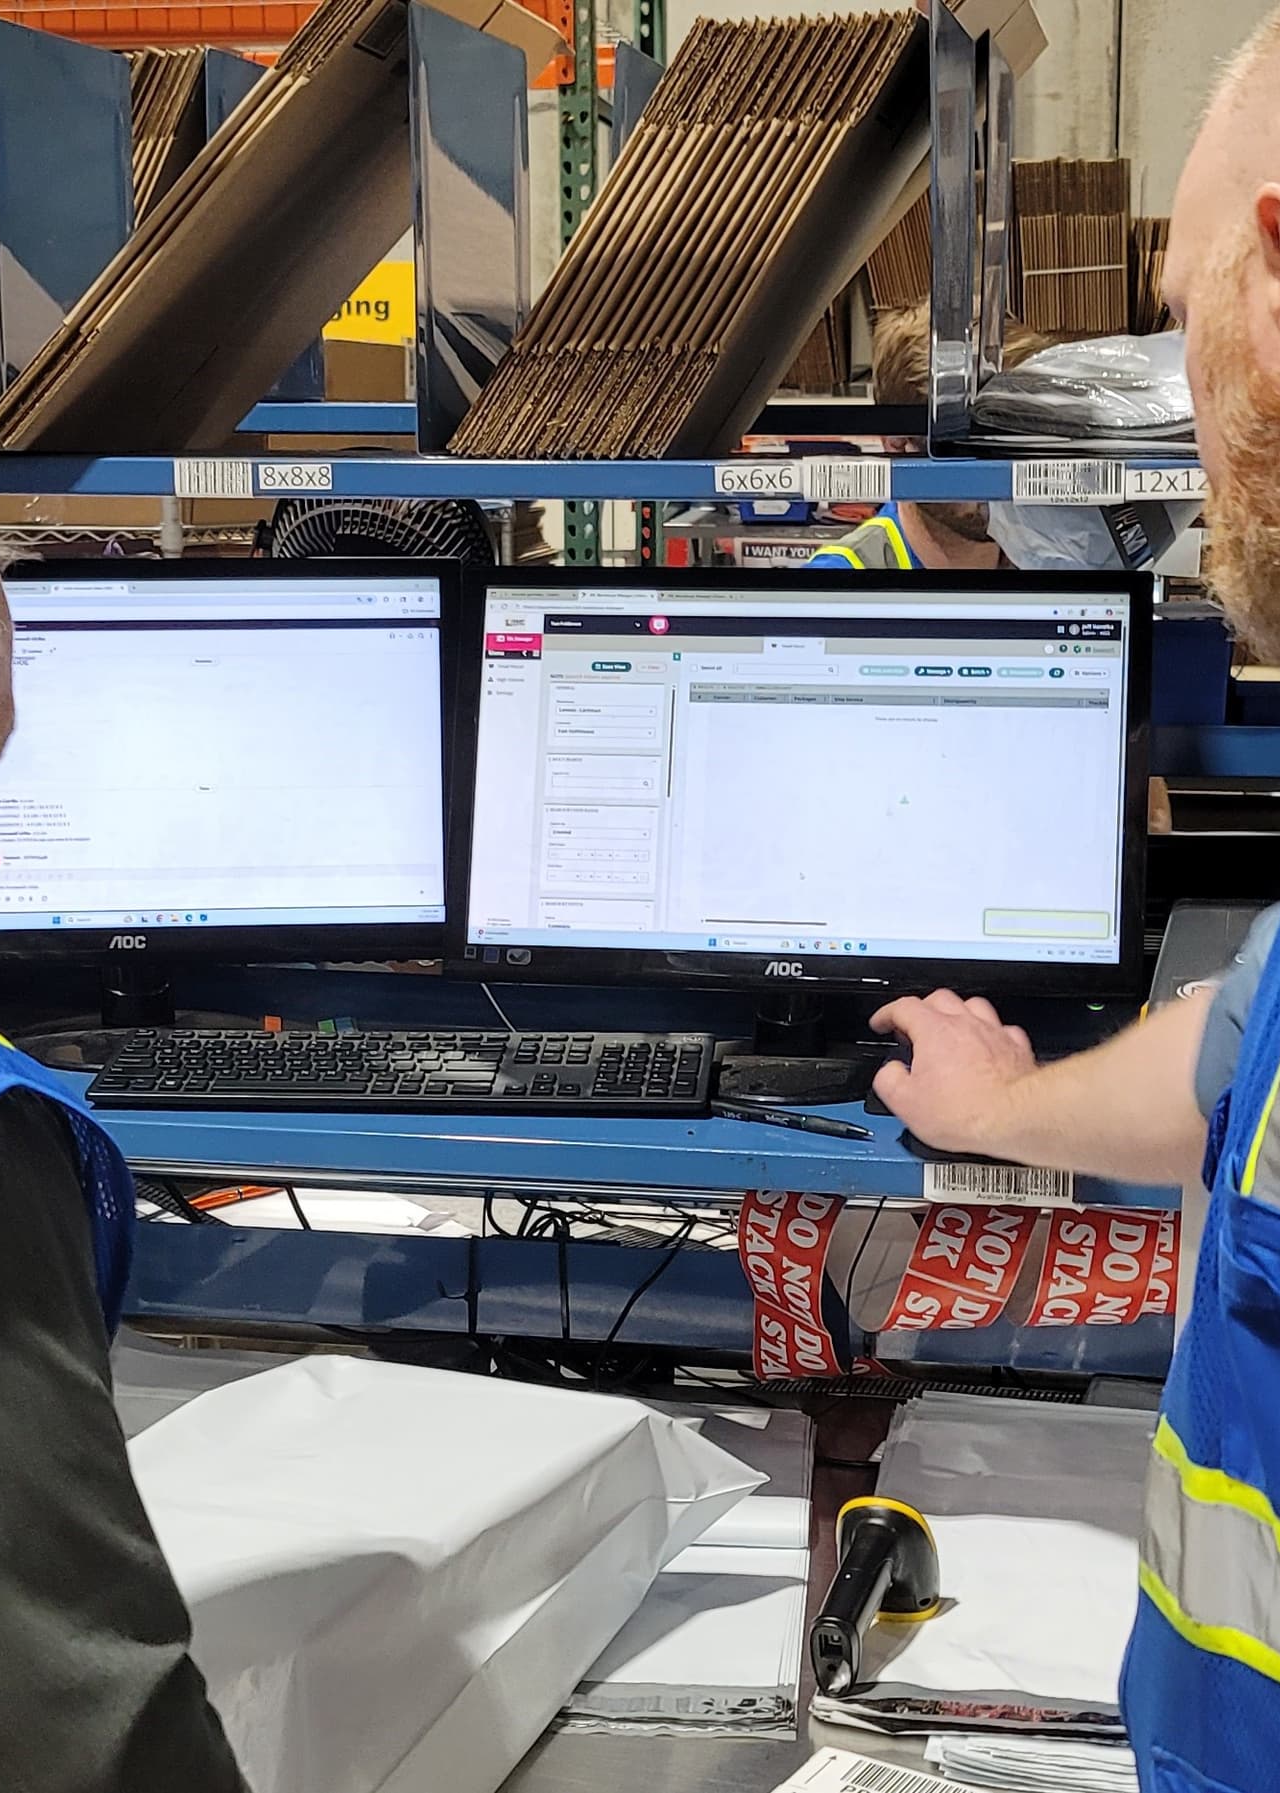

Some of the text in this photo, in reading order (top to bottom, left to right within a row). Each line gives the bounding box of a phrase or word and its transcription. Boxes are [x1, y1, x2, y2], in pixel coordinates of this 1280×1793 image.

[263, 466, 331, 487] 8x8x8
[721, 467, 793, 491] 6x6x6
[751, 546, 788, 557] WANT
[109, 935, 146, 949] AOC
[765, 961, 803, 977] AOC
[966, 1208, 1024, 1293] NOT
[1102, 1219, 1147, 1282] DO
[892, 1291, 942, 1330] ST
[761, 1314, 791, 1380] STA
[794, 1323, 828, 1370] DO
